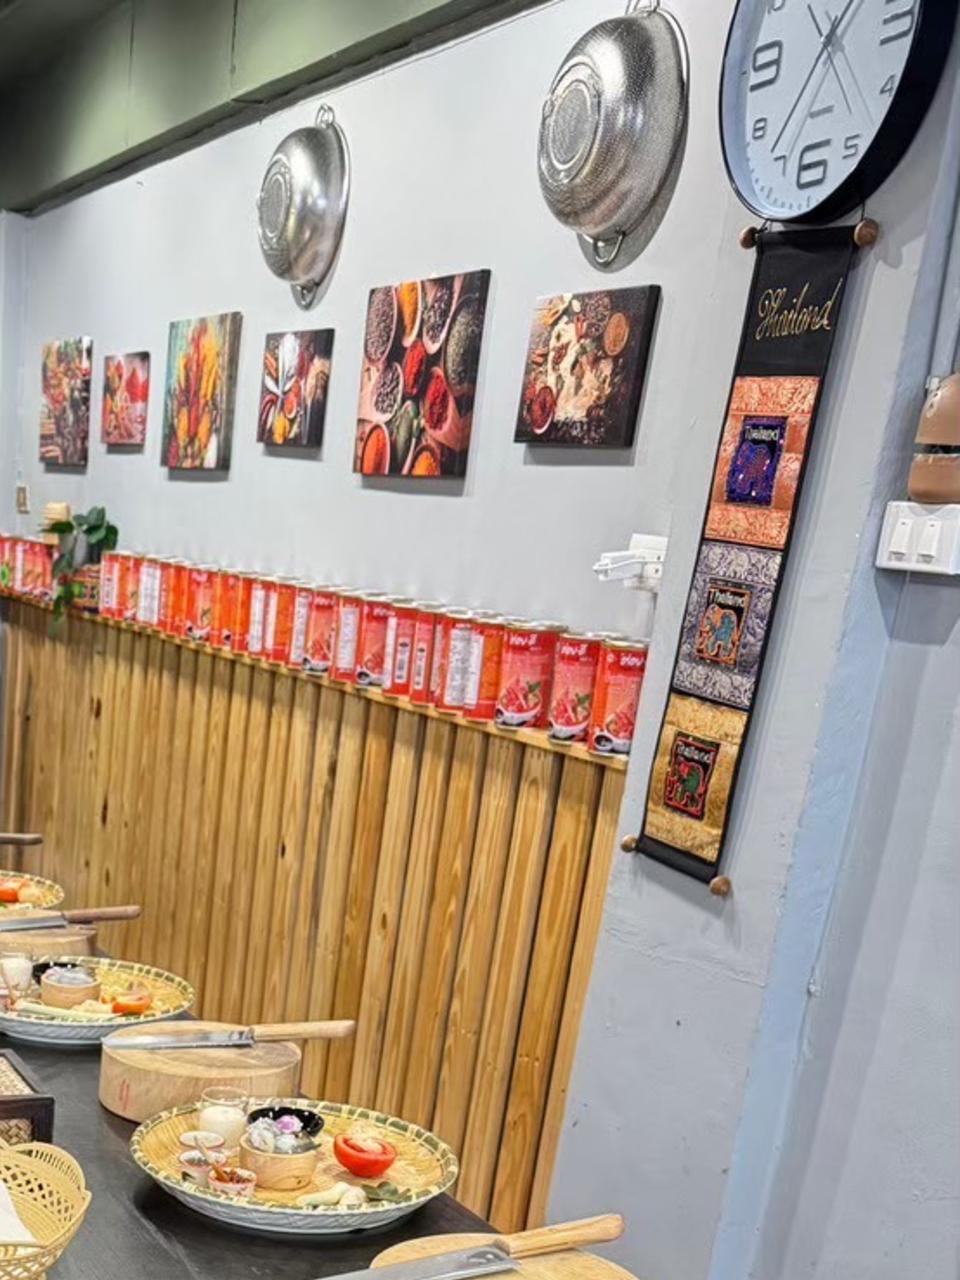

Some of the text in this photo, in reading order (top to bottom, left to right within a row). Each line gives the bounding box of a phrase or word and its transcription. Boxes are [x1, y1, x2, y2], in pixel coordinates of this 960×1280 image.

[749, 39, 783, 93] 9
[879, 74, 895, 97] 4
[752, 117, 767, 140] 8
[842, 134, 861, 160] 5
[773, 154, 788, 178] 7
[796, 138, 832, 190] 6
